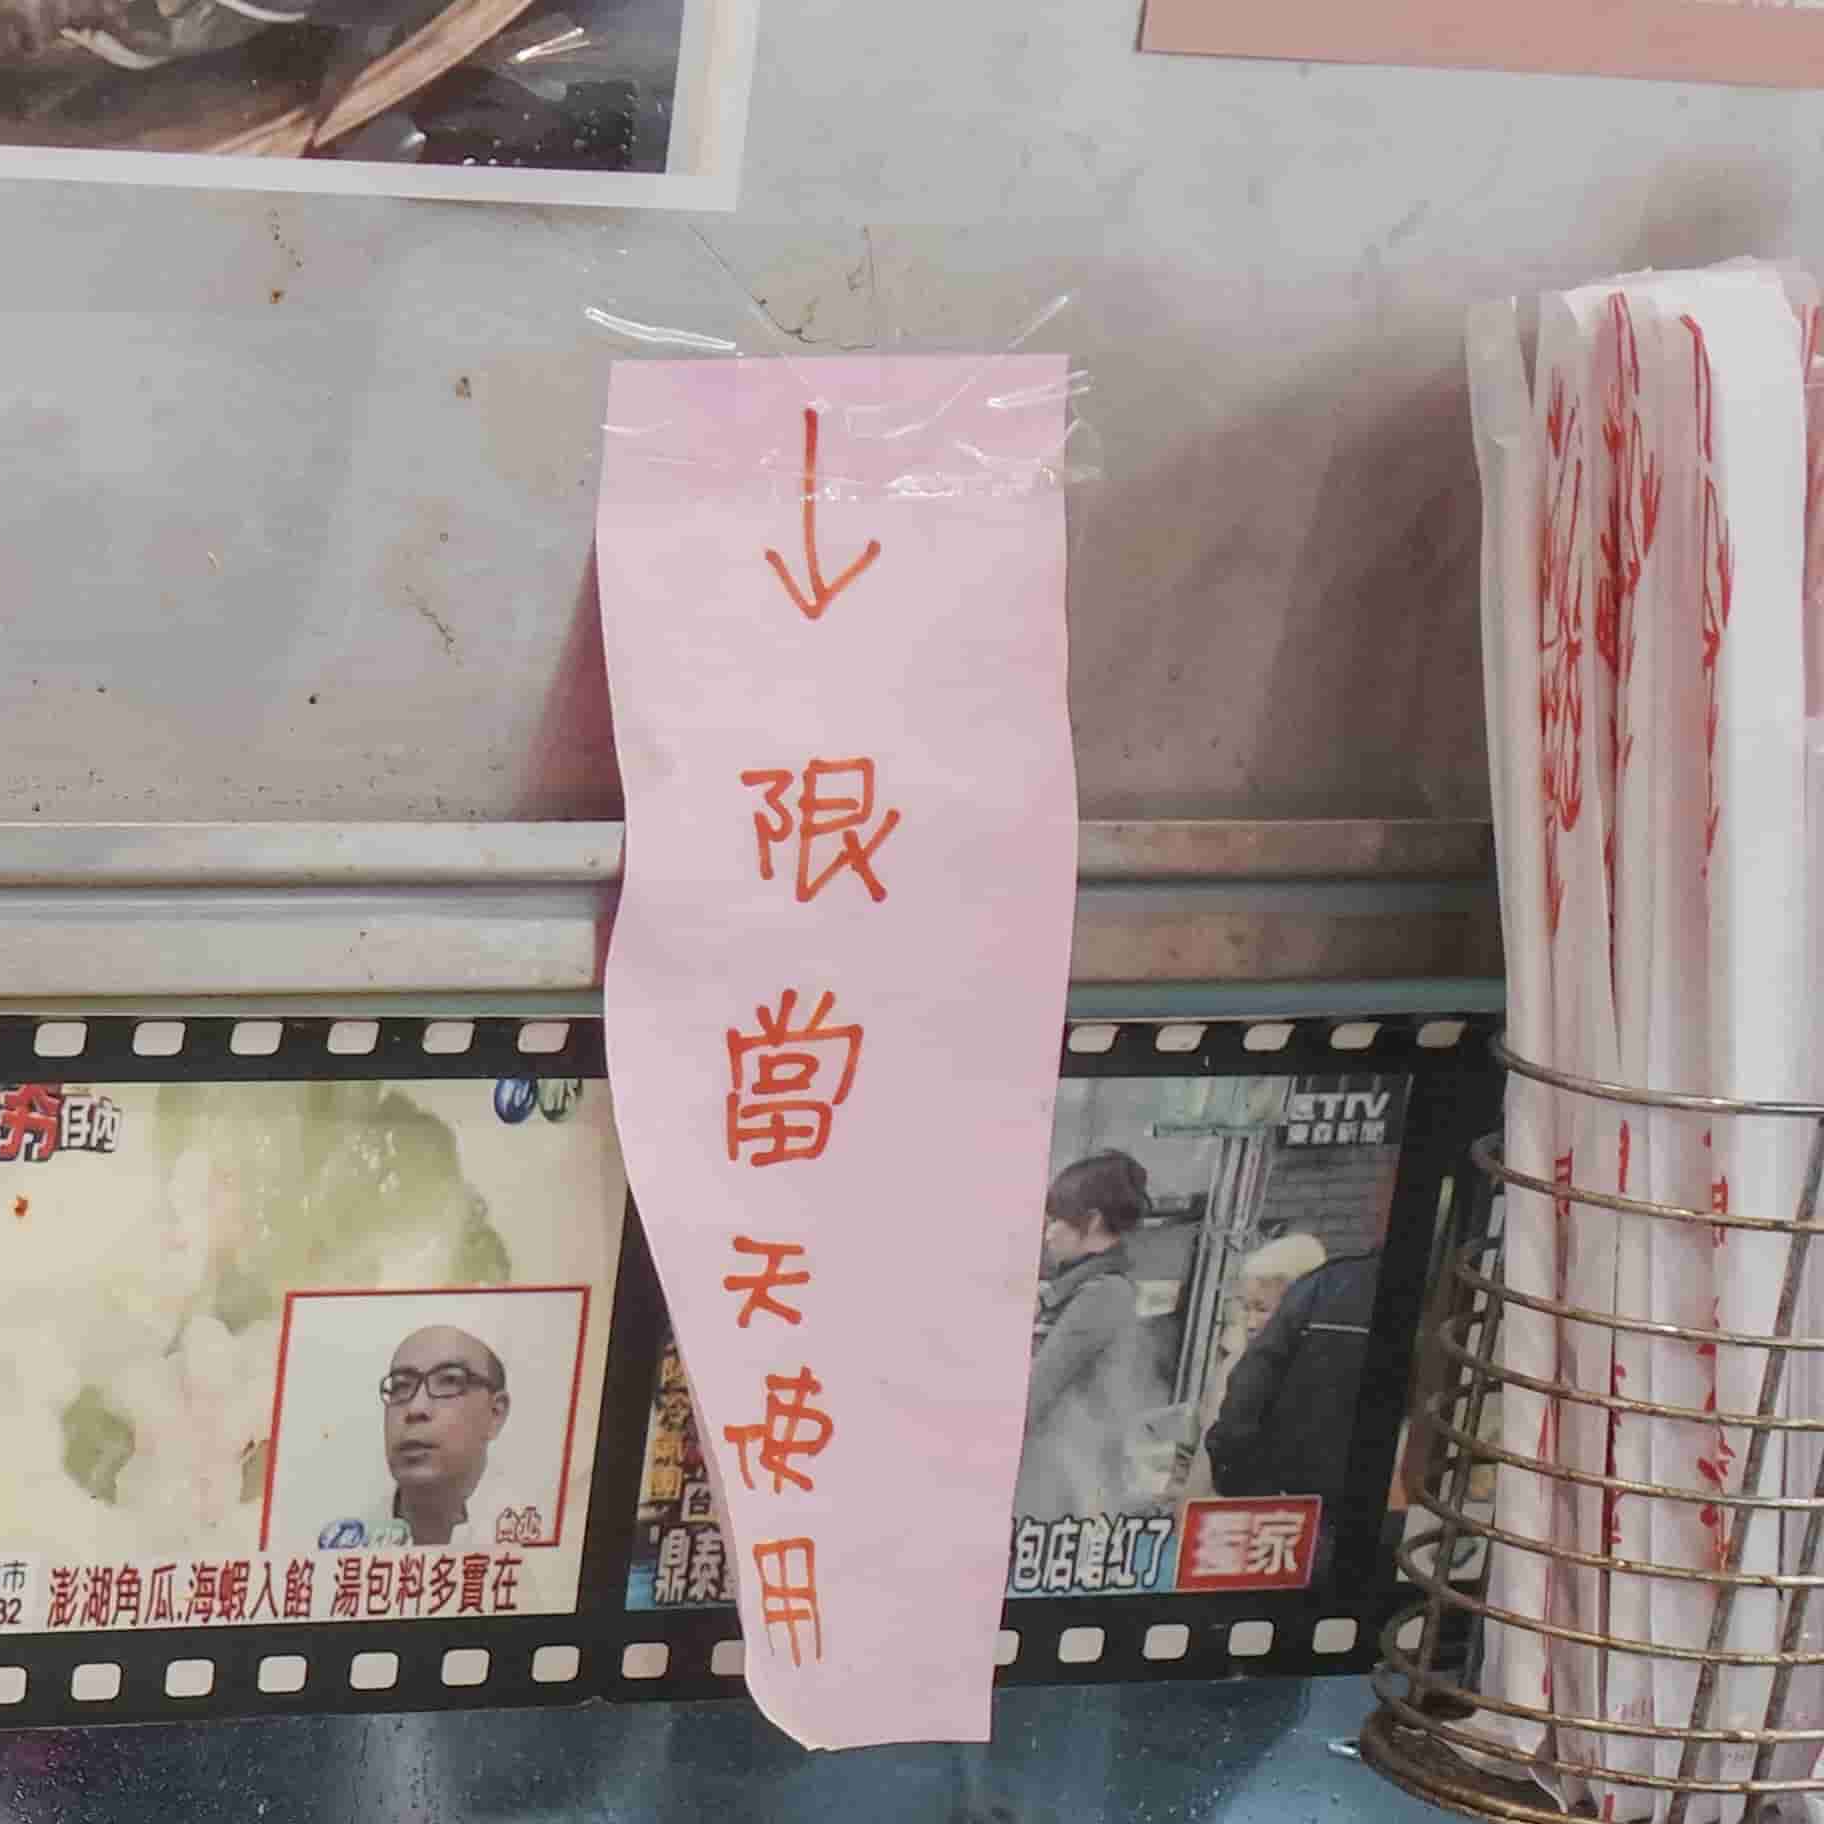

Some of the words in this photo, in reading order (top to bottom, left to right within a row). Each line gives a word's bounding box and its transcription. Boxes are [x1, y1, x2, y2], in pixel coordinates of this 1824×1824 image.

[723, 756, 901, 1668] 限當天使用
[329, 1552, 523, 1617] 湯包料多實在
[655, 1527, 739, 1608] 鼎泰
